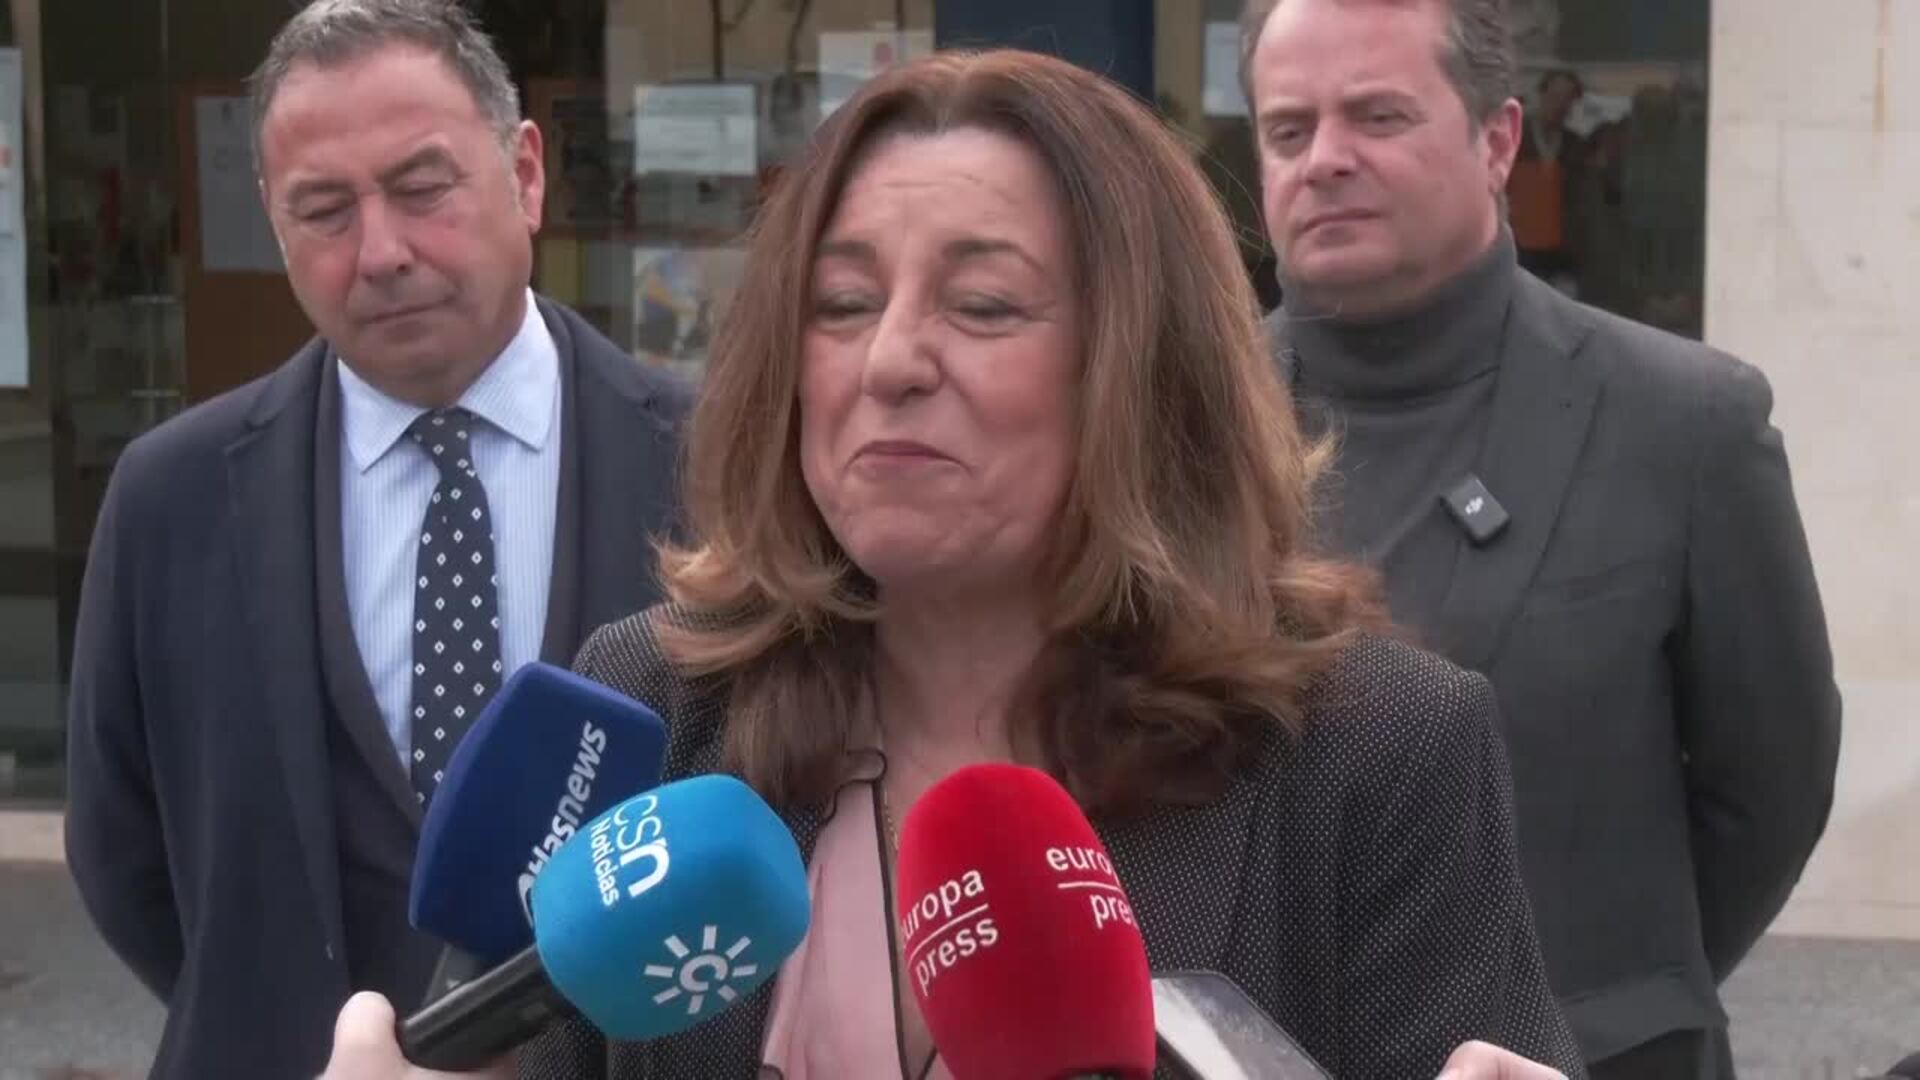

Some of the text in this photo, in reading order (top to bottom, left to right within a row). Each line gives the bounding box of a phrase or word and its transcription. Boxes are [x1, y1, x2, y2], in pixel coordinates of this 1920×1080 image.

[590, 816, 620, 907] Noticias
[1046, 846, 1121, 889] euro
[901, 869, 985, 944] uropa
[915, 918, 998, 998] press
